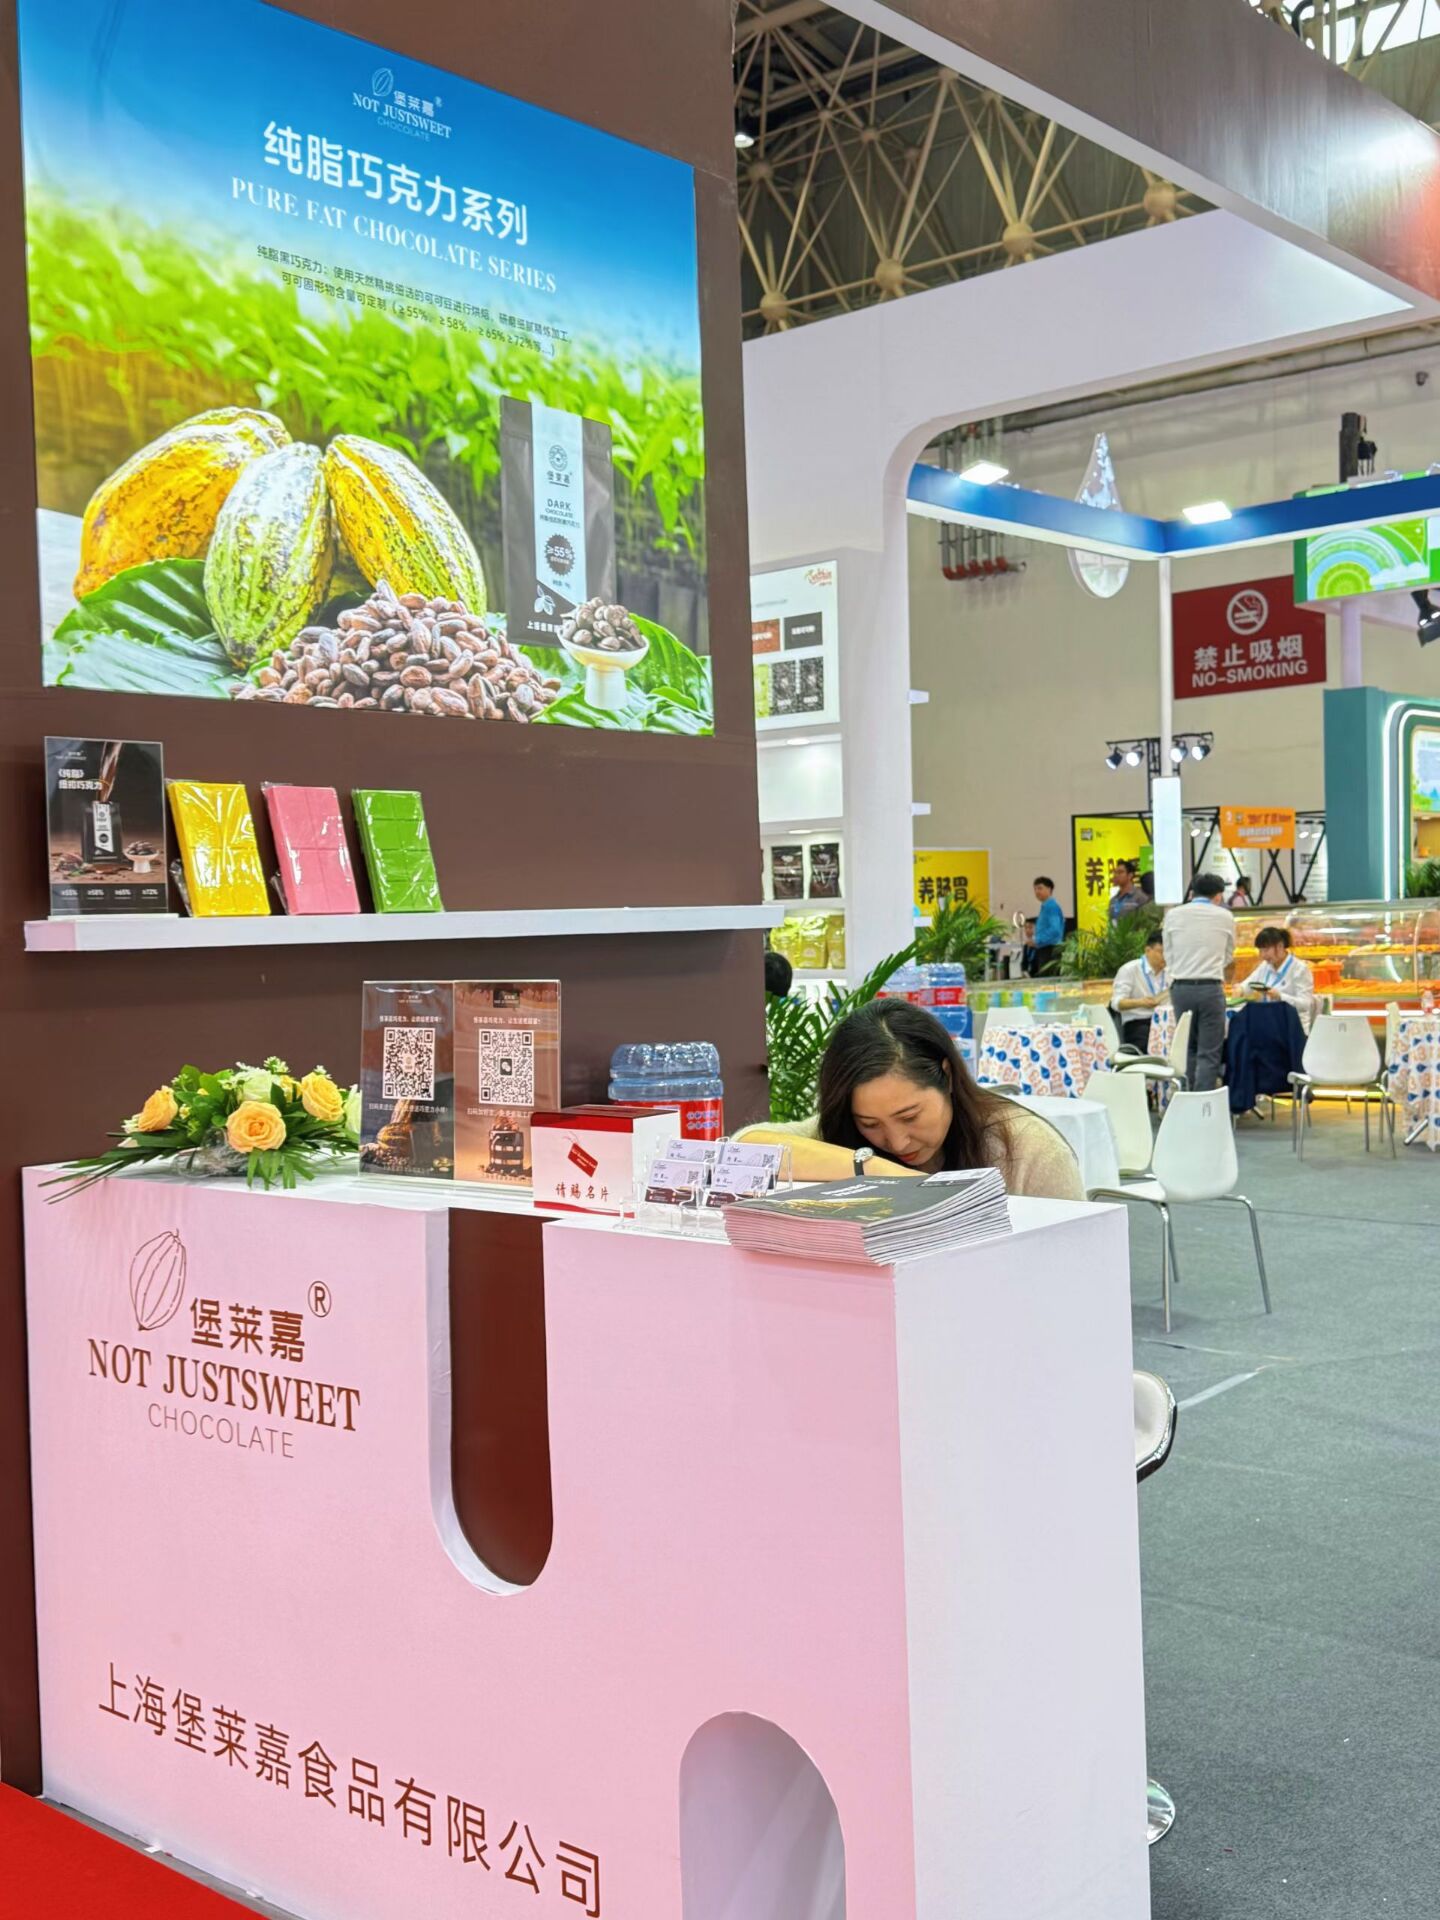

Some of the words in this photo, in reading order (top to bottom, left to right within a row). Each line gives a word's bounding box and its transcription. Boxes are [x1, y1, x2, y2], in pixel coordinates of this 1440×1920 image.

[353, 92, 379, 113] NOT
[383, 104, 451, 138] JUSTSWEET
[377, 116, 430, 141] CHOCOLATE
[263, 120, 528, 246] 纯脂巧克力系列
[231, 177, 299, 217] PURE
[307, 199, 347, 230] FAT
[353, 215, 483, 272] CHOCOLATE
[488, 255, 557, 294] SERIES
[547, 498, 572, 511] DARK
[1191, 659, 1308, 688] NO-SMOKING
[1194, 634, 1303, 671] 禁止吸烟
[555, 1182, 609, 1202] 请赐名片
[190, 1297, 305, 1362] 堡莱嘉
[88, 1338, 152, 1388] NOT
[163, 1354, 361, 1431] JUSTSWEET
[148, 1403, 294, 1458] CHOCOLATE
[99, 1662, 601, 1919] 上海堡莱嘉食品有限公司
